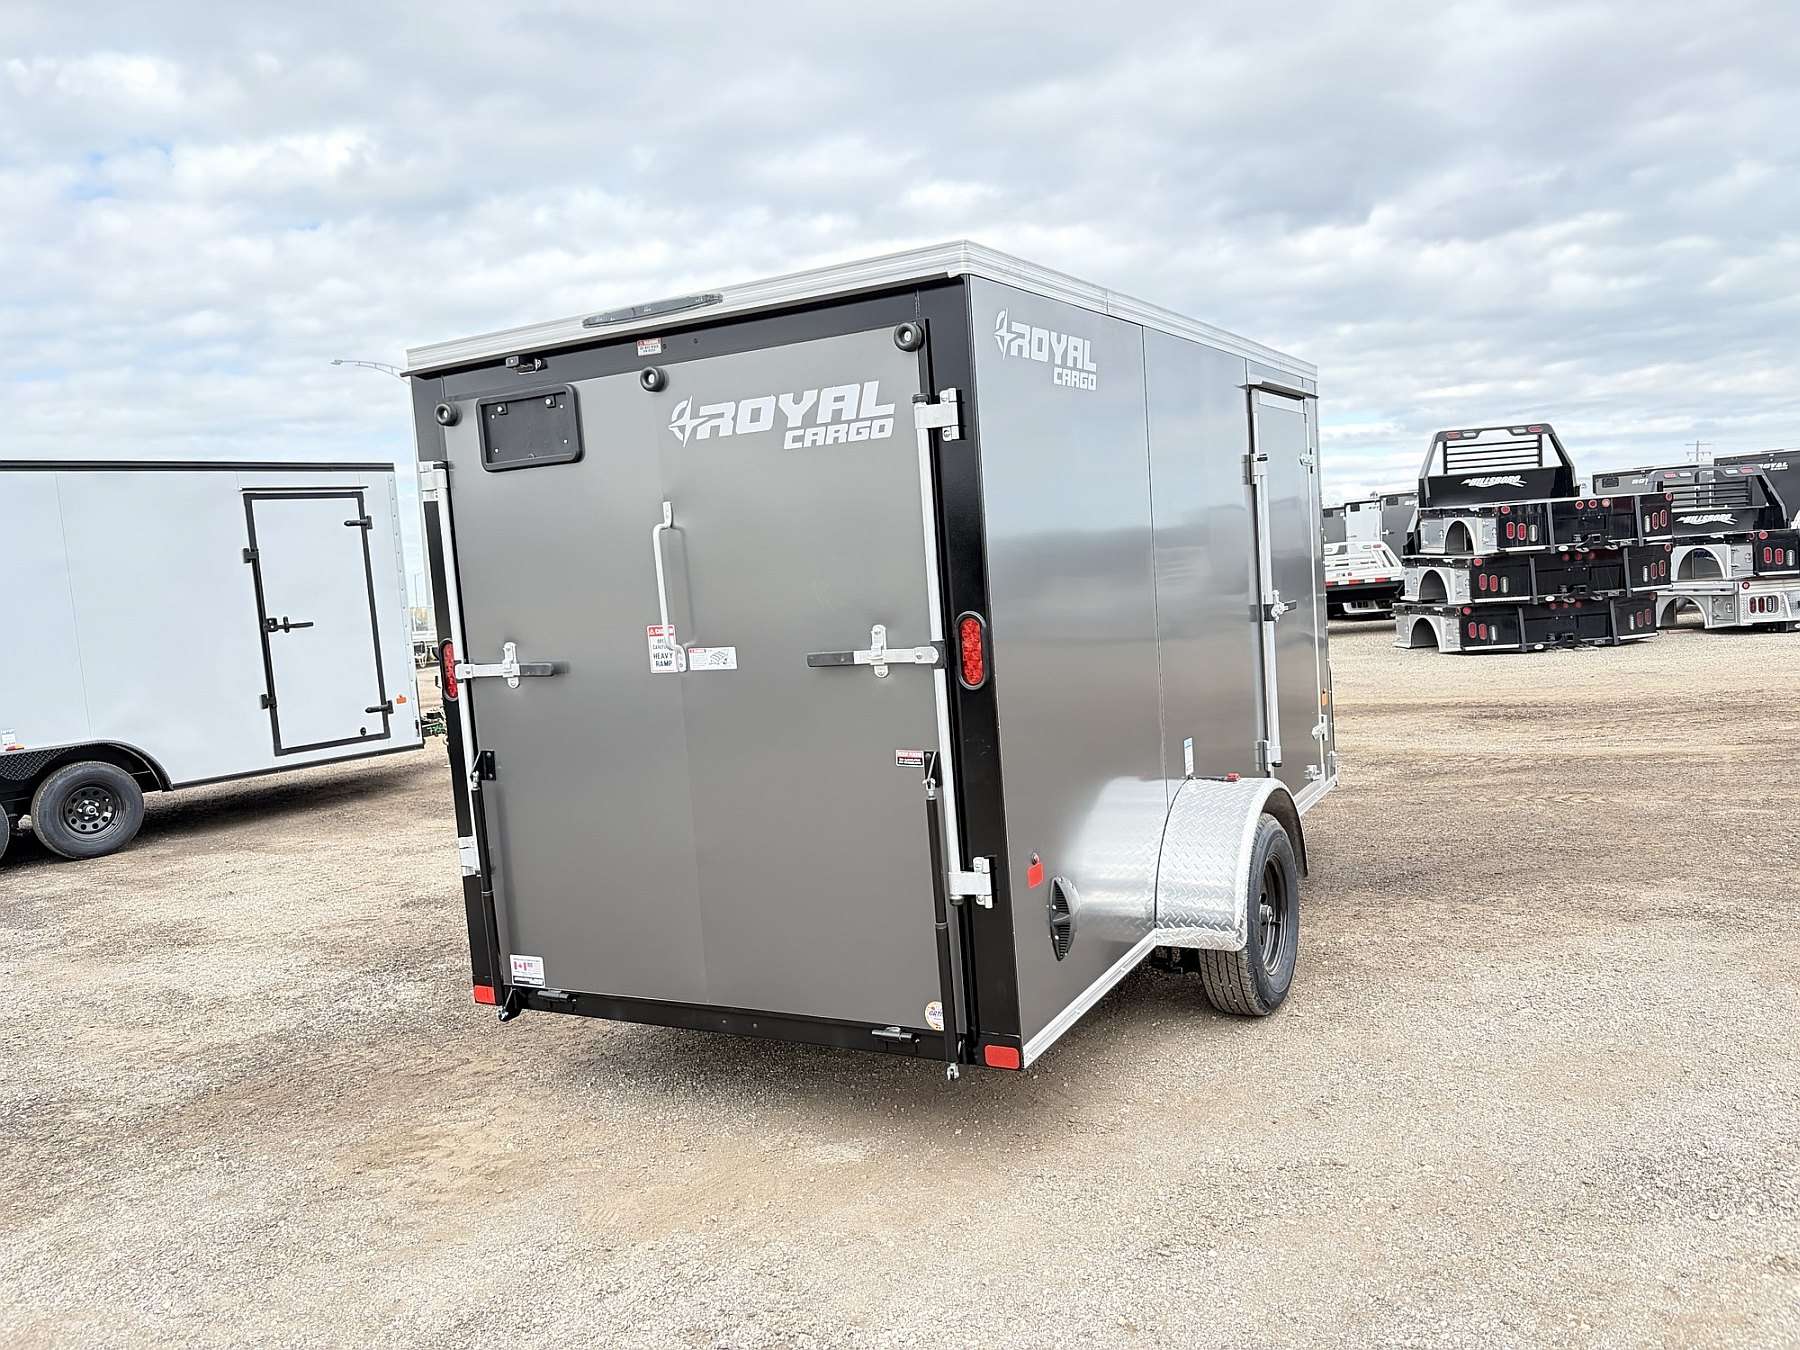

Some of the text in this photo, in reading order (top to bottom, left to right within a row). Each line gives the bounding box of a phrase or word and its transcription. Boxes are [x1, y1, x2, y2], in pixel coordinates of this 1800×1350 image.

[1010, 321, 1097, 373] ROYAL
[1053, 367, 1097, 391] CARGO
[696, 380, 896, 440] ROYAL
[783, 418, 895, 450] CARGO
[1462, 475, 1526, 488] HILLSBORO
[1676, 513, 1738, 525] HILLSBORO
